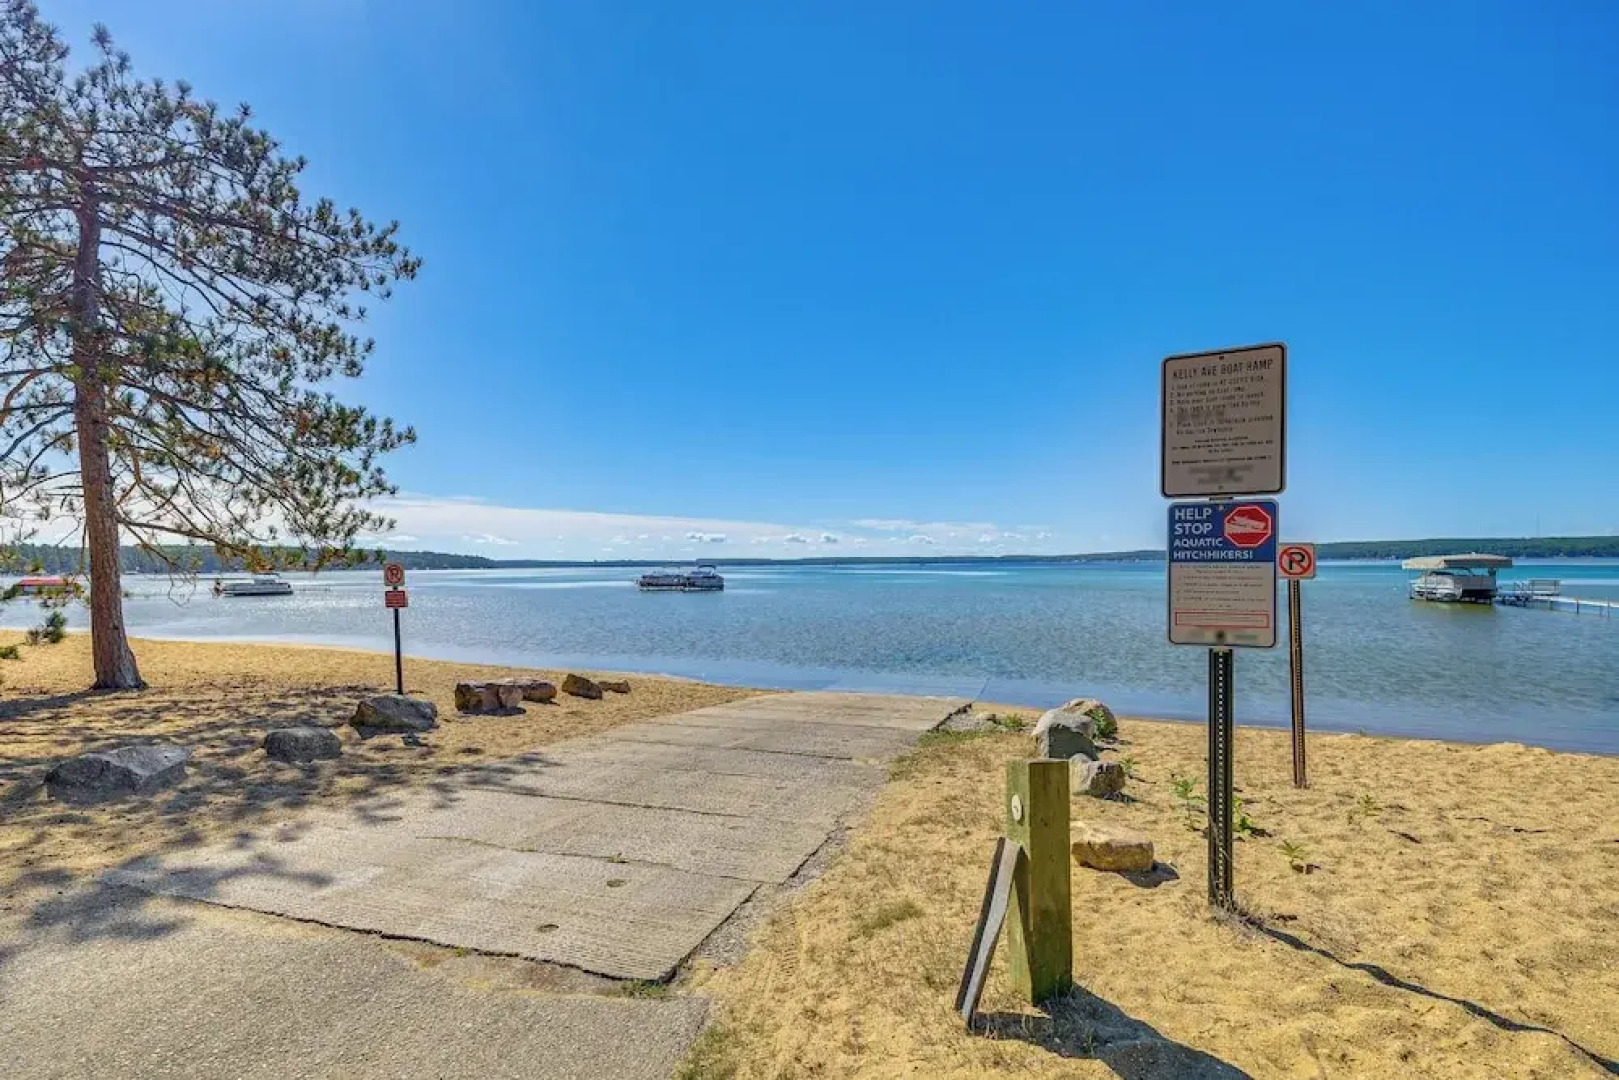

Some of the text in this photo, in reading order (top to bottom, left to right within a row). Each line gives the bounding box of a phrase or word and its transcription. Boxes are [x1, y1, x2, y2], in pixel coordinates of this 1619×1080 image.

[1173, 368, 1197, 379] KELLY
[1220, 362, 1243, 375] BOAT
[1246, 359, 1273, 371] RAMP
[1174, 507, 1212, 521] HELP
[1174, 522, 1213, 535] STOP
[1173, 537, 1223, 548] AQUATIC
[1173, 550, 1253, 560] HITCHHIKERS!
